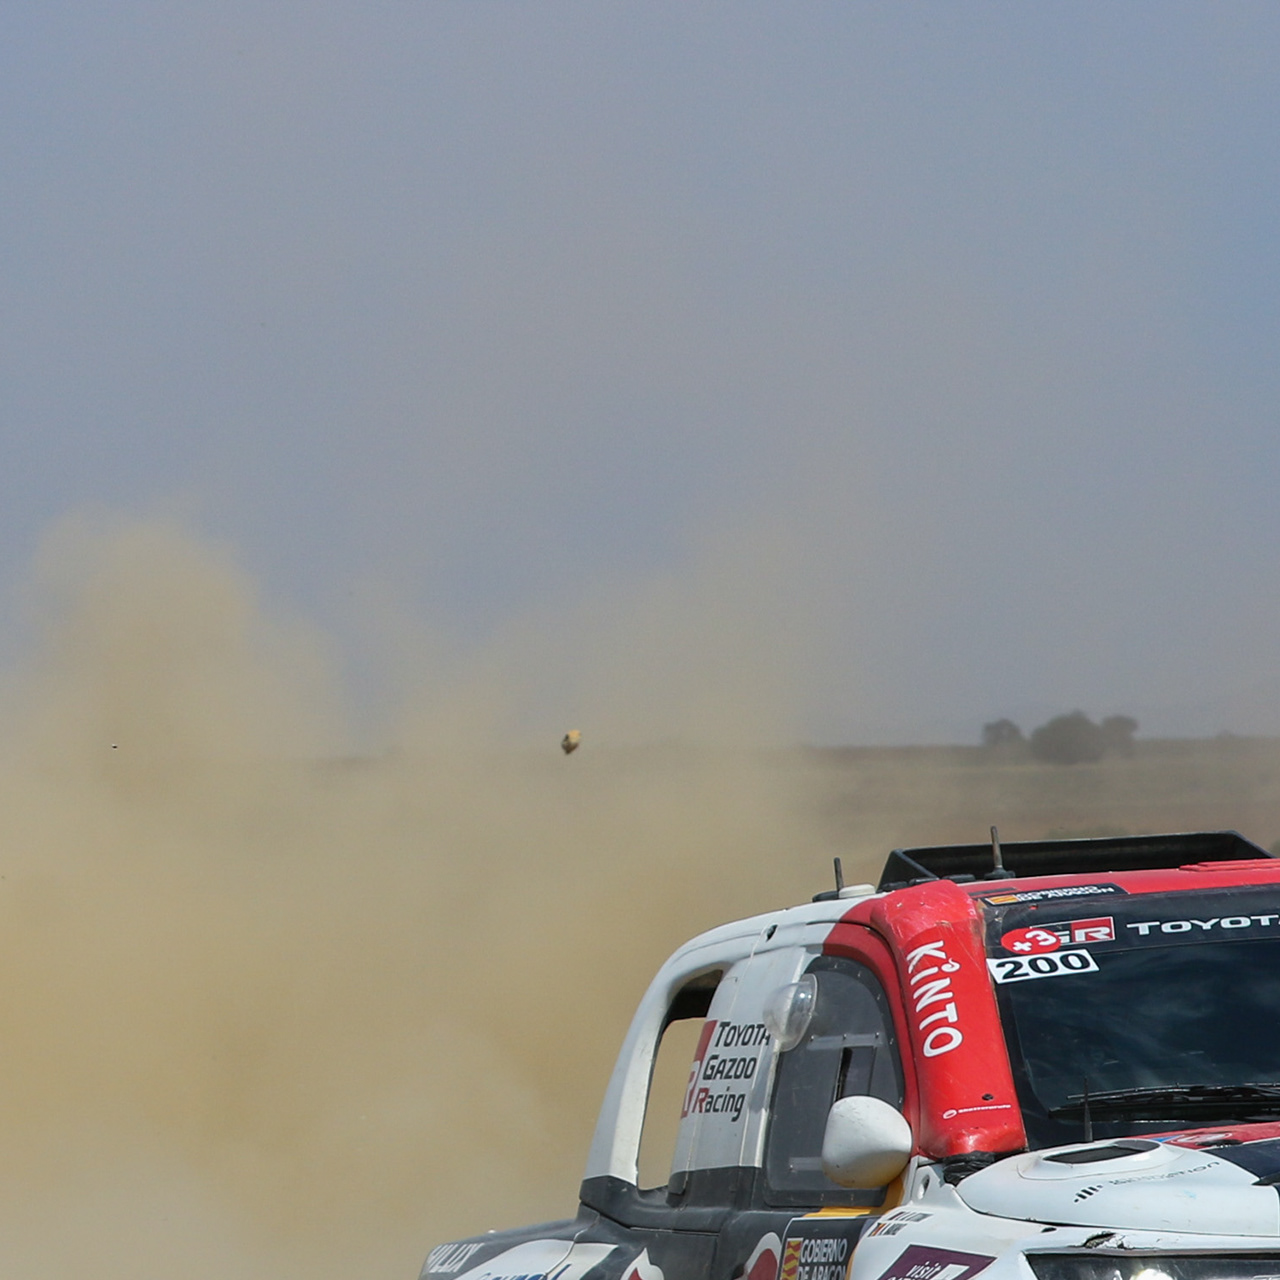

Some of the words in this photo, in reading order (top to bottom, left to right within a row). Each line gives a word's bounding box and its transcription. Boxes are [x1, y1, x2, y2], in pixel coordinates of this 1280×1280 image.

[996, 952, 1091, 980] 200
[715, 1021, 771, 1048] TOYOTA
[703, 1054, 757, 1080] GAZOO
[691, 1086, 746, 1122] Racing
[800, 1238, 848, 1263] GOBIERNO
[905, 1261, 942, 1280] visit
